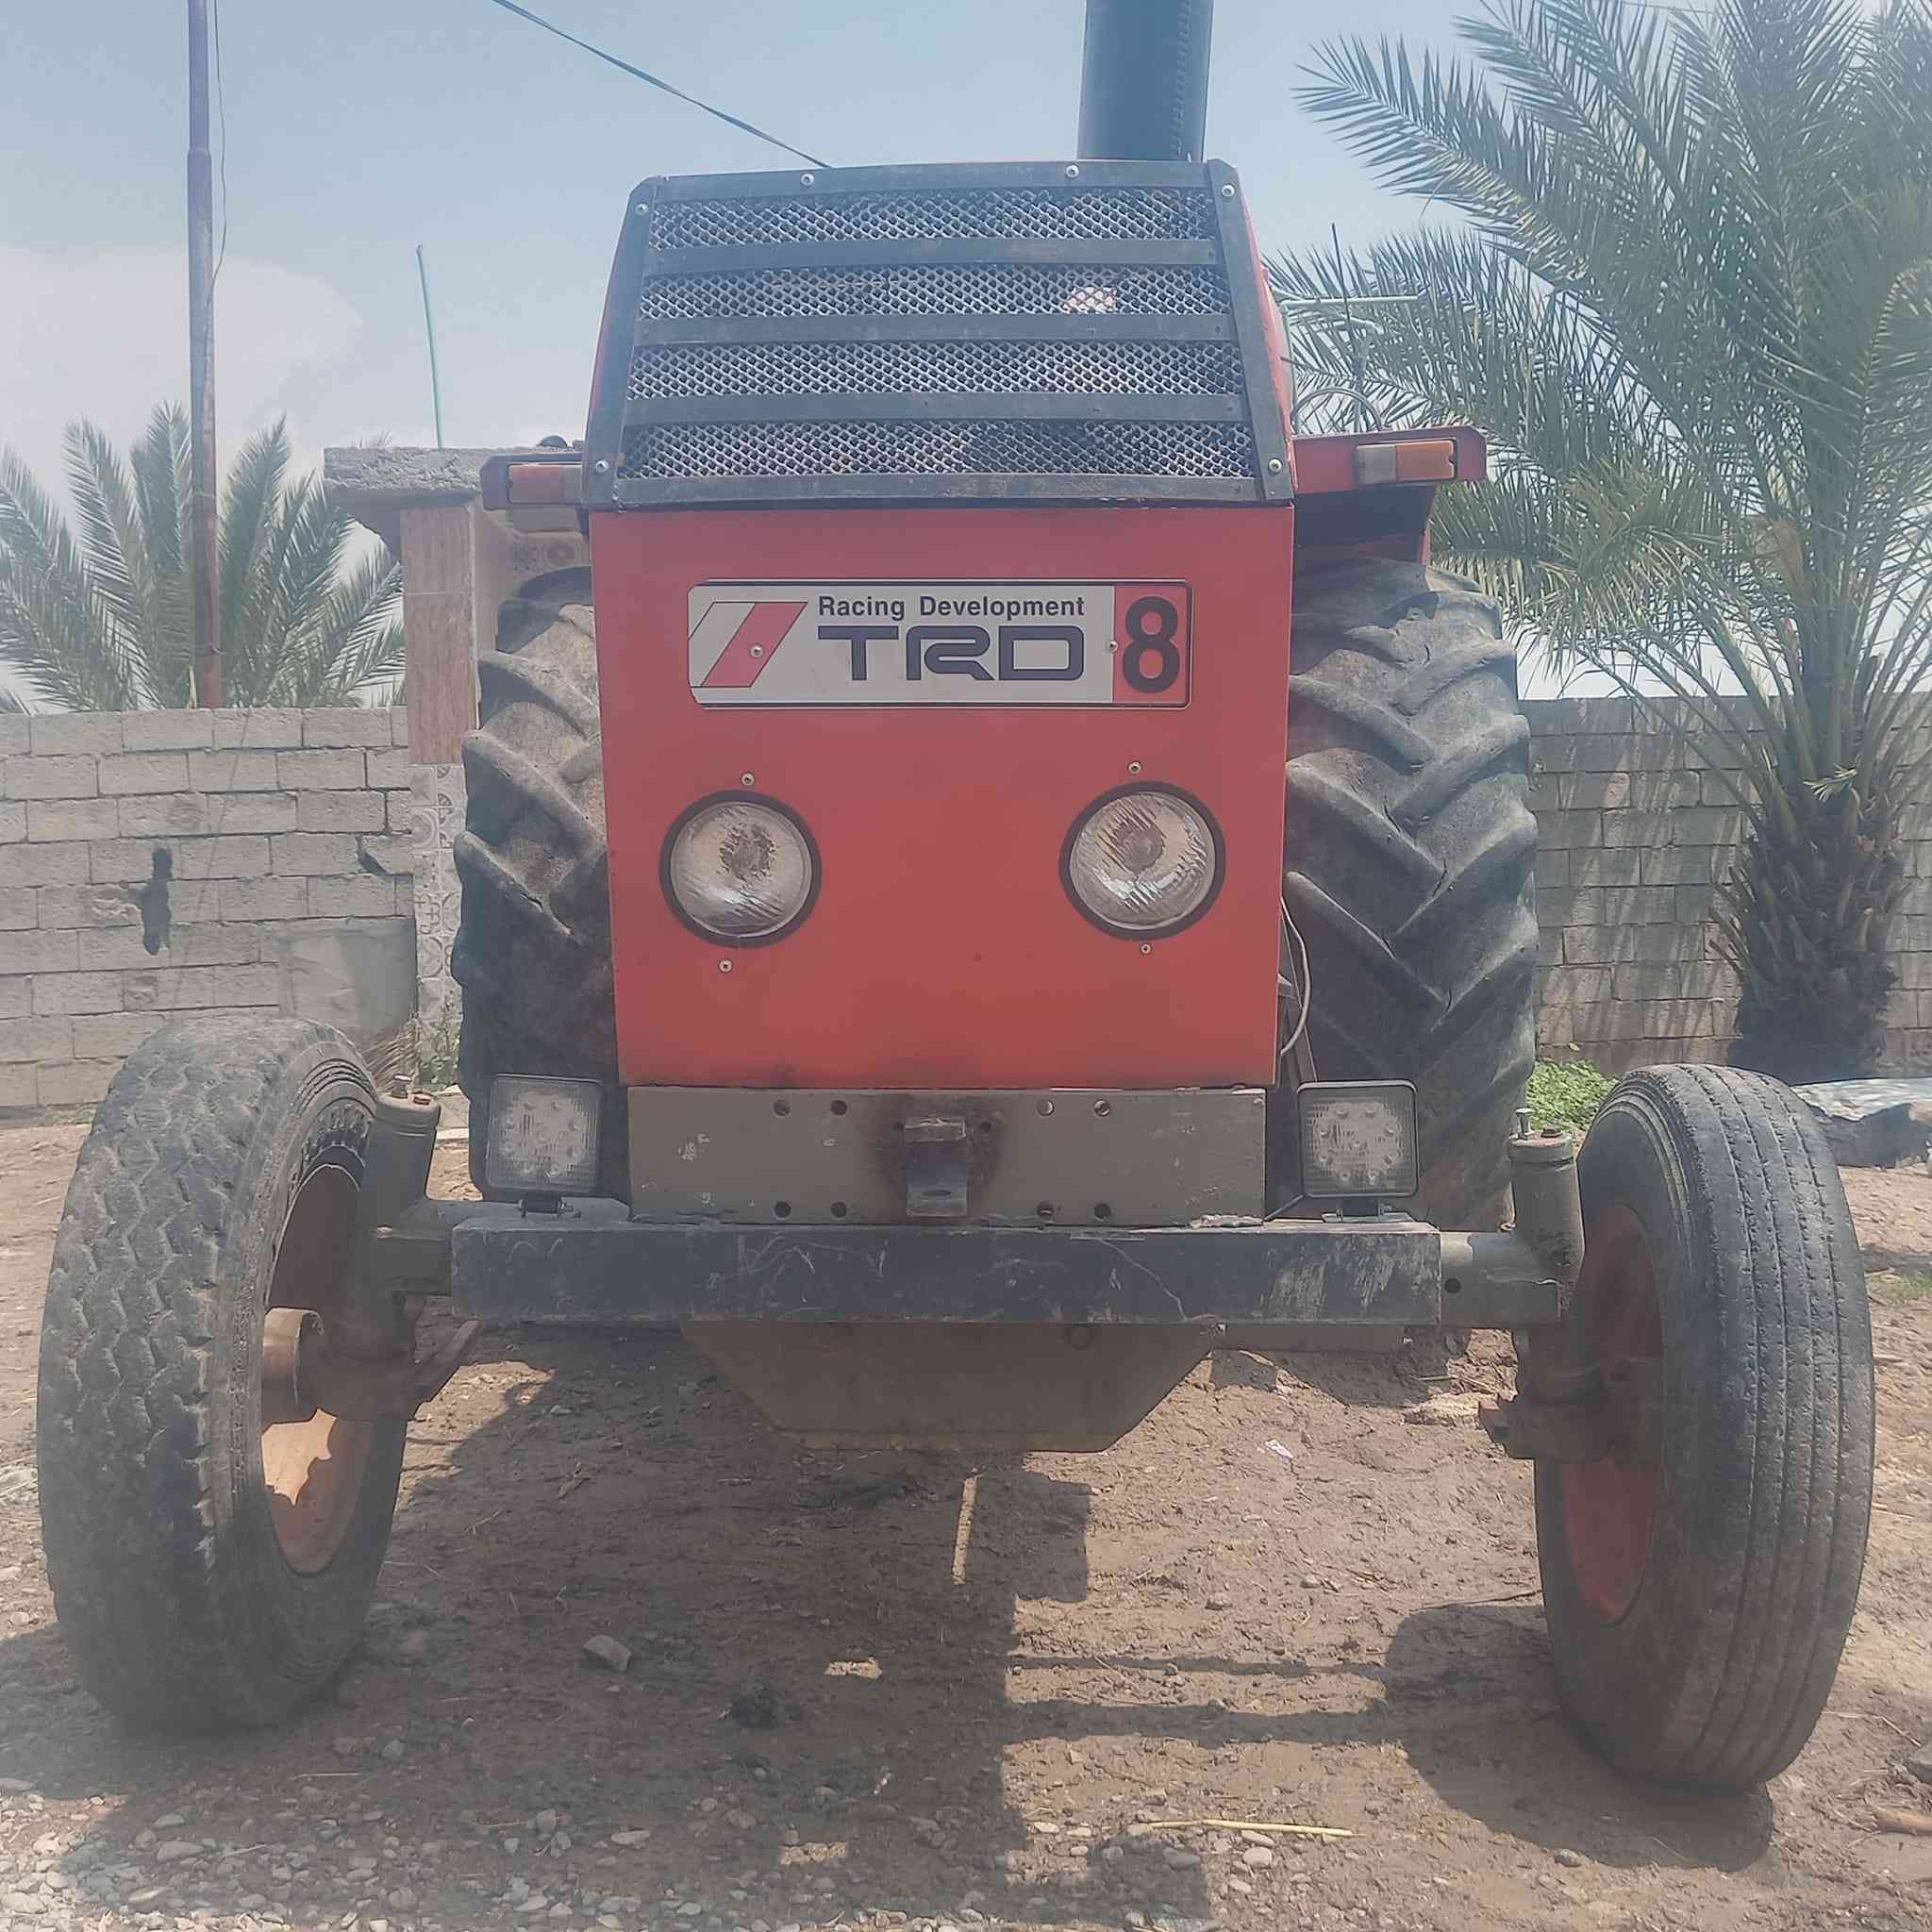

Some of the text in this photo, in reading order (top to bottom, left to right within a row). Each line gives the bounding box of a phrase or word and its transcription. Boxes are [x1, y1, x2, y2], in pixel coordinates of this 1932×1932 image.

[819, 596, 1084, 621] Racing Development
[818, 625, 1083, 680] TRD
[1123, 596, 1180, 692] 8
